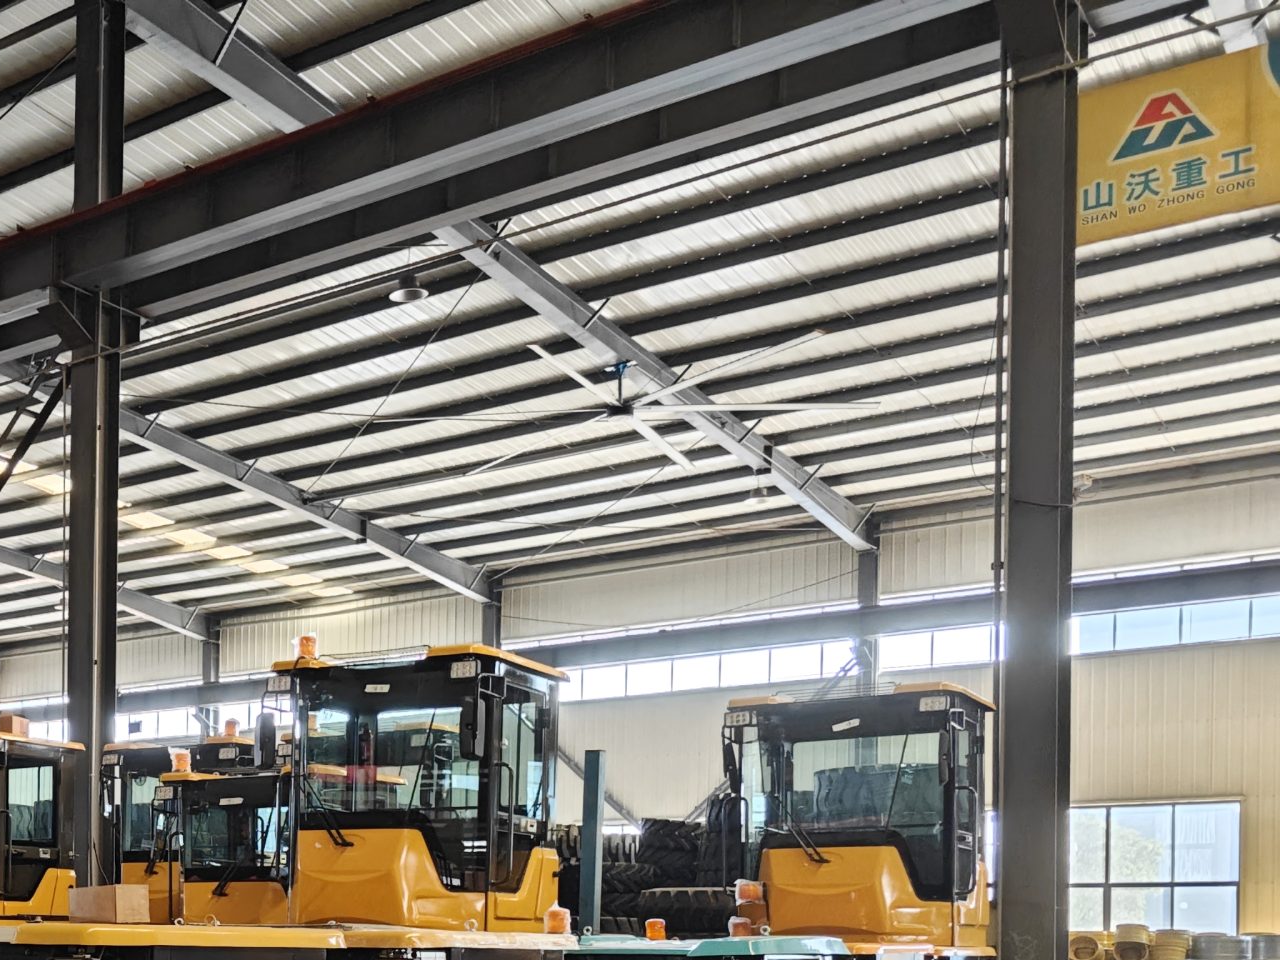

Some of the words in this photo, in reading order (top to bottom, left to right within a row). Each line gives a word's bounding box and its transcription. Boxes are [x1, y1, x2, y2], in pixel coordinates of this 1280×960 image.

[1081, 209, 1118, 226] SHAN
[1127, 203, 1147, 216] WO
[1157, 190, 1206, 209] ZHONG
[1216, 178, 1256, 195] GONG
[1082, 147, 1255, 212] 山沃重工
